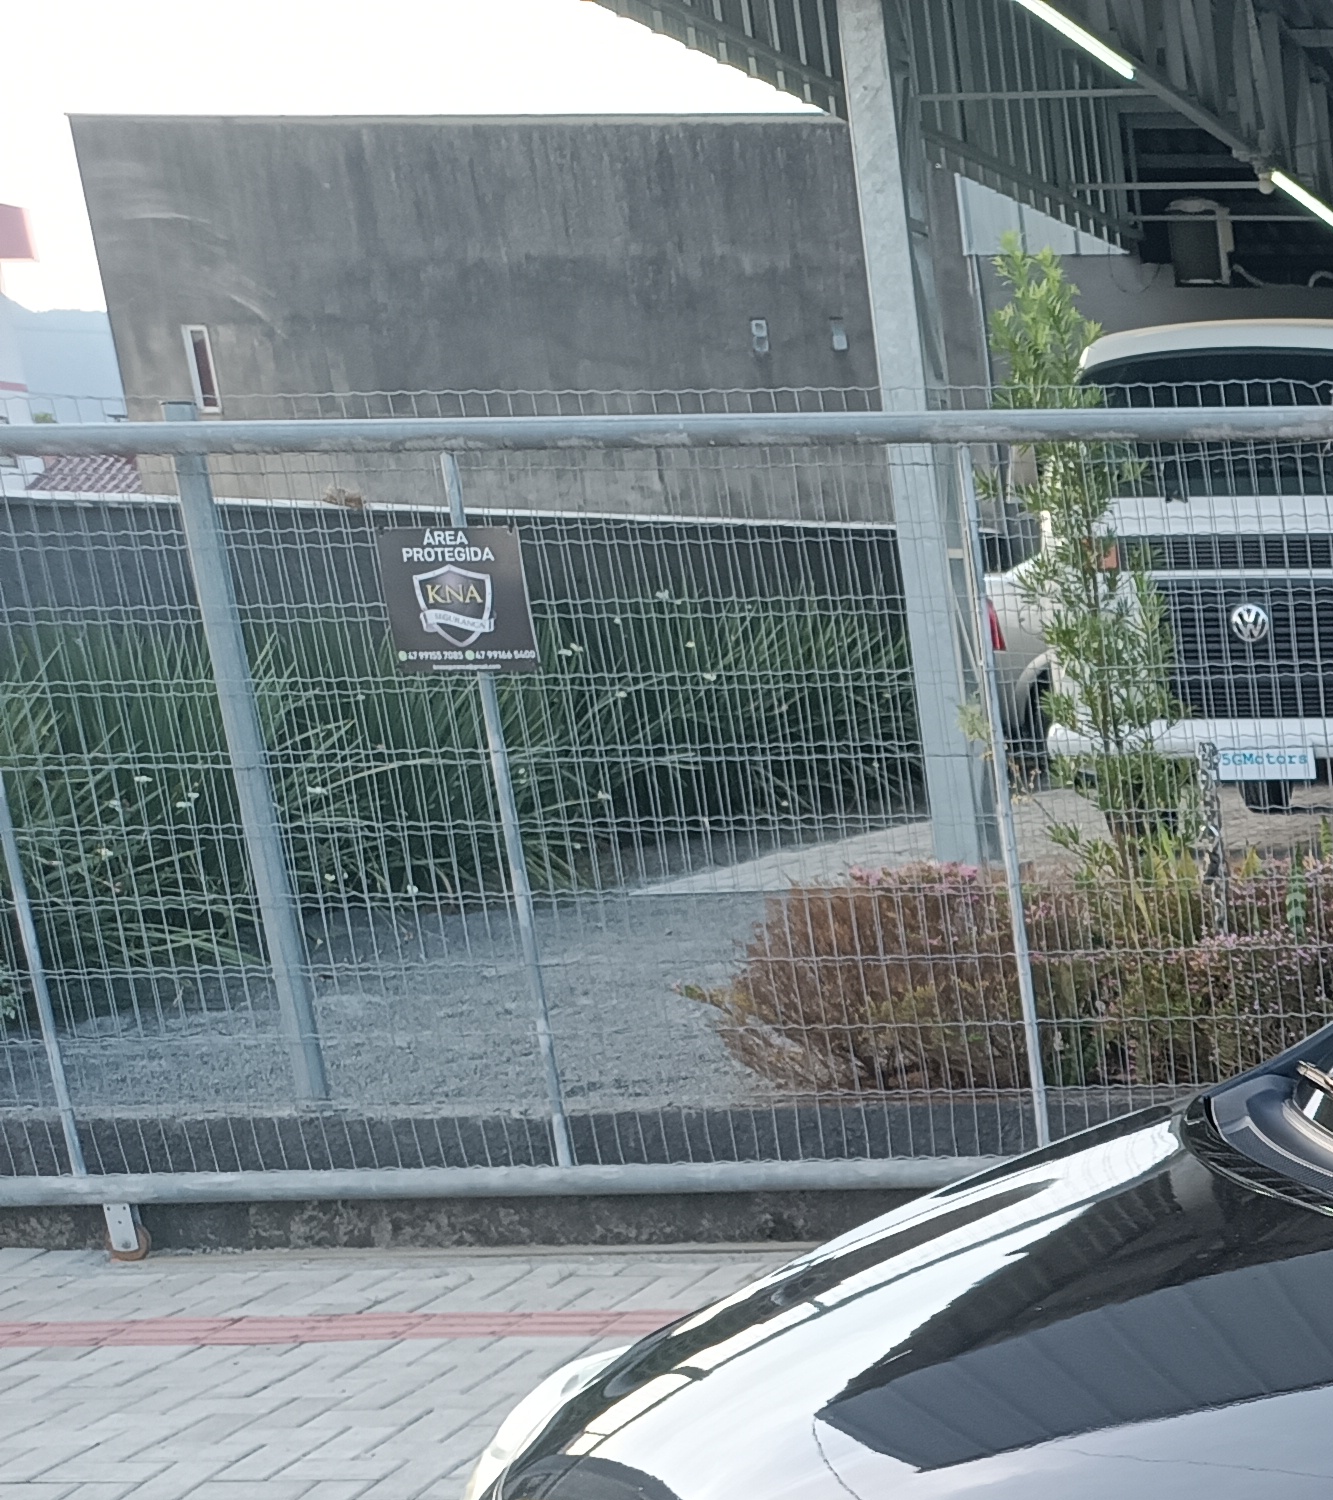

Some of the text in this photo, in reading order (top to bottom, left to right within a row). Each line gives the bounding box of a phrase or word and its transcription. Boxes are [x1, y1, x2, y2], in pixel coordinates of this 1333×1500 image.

[423, 528, 469, 546] ÁREA
[401, 546, 495, 562] PROTEGIDA
[425, 584, 484, 604] KNA
[1221, 753, 1308, 766] 5GMotors
